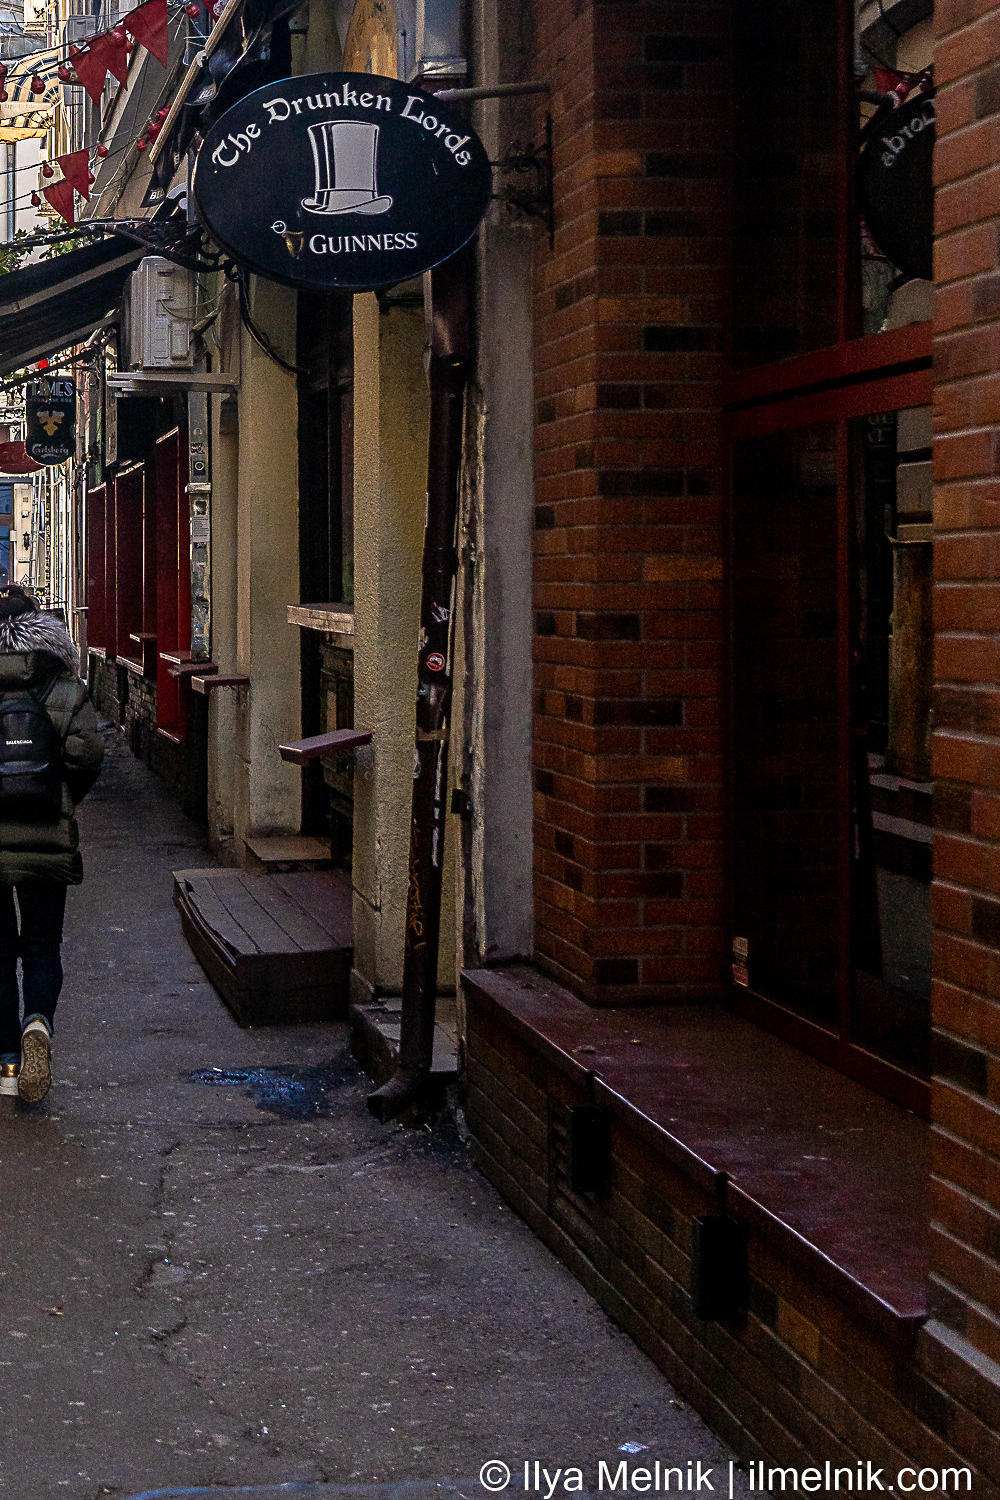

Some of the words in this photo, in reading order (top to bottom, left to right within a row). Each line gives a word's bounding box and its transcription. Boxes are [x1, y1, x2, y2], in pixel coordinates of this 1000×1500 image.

[211, 121, 262, 168] The
[262, 82, 392, 125] Drunken
[399, 95, 472, 167] Lords
[309, 231, 419, 255] GUINNESS
